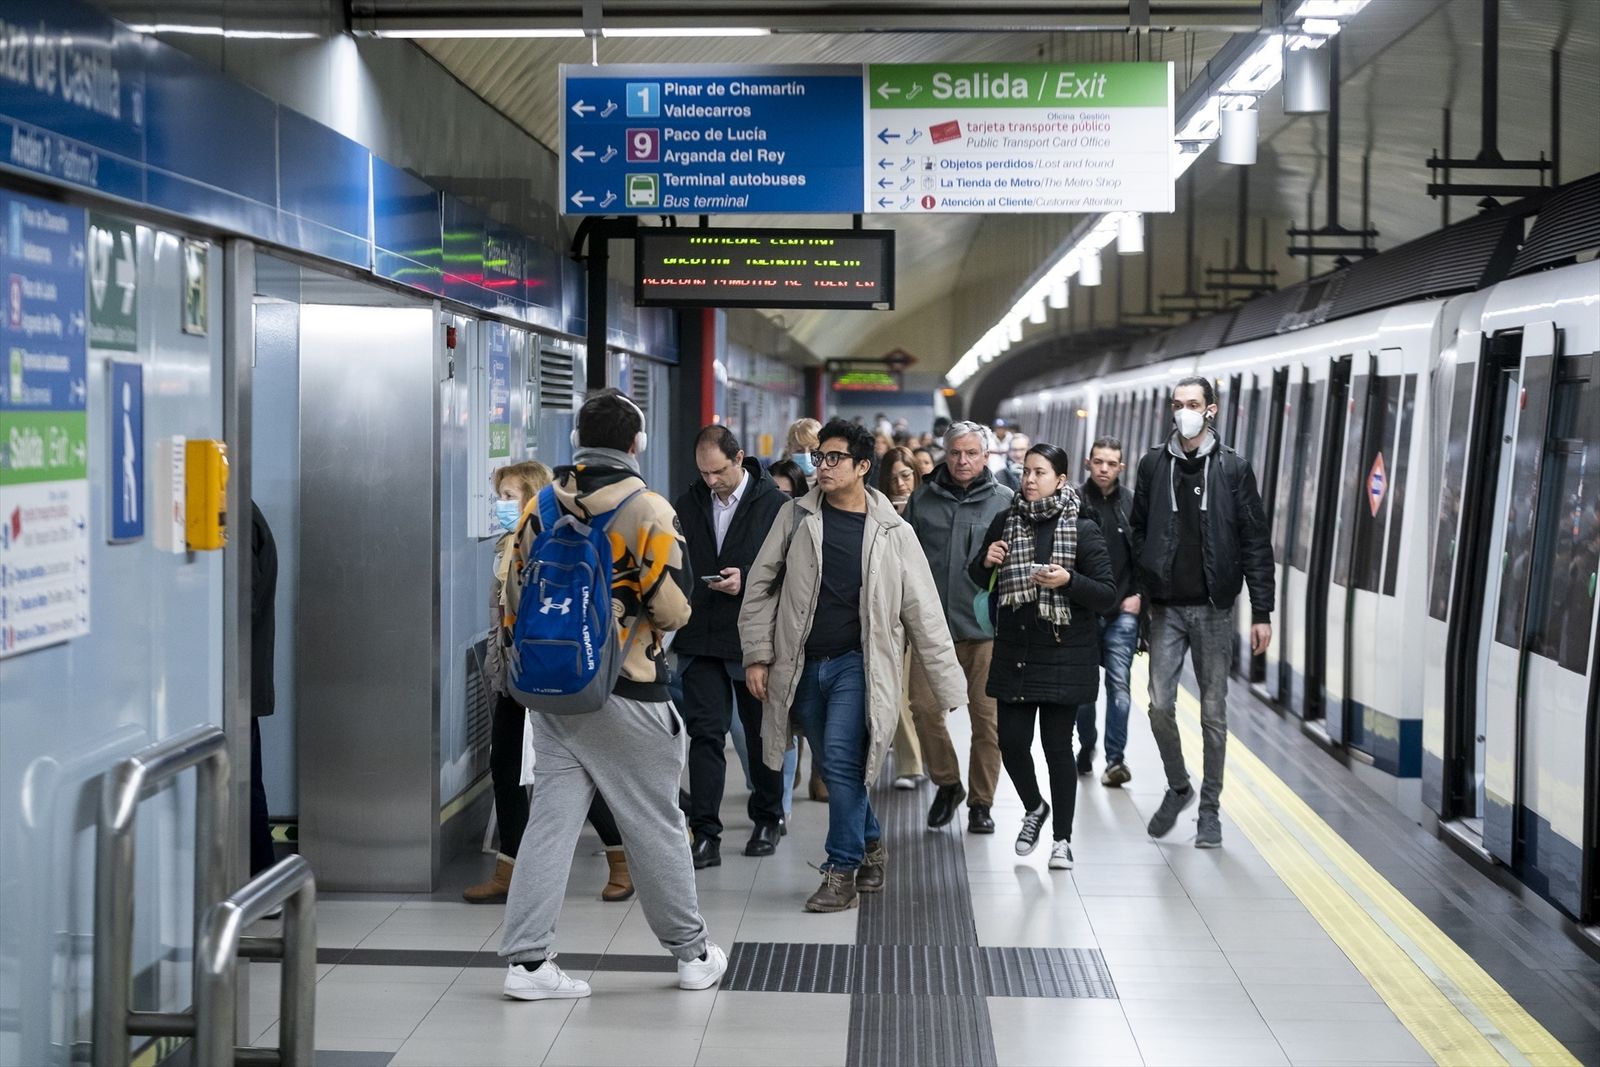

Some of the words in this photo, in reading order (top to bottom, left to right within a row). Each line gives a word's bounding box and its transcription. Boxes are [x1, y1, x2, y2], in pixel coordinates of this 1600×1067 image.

[665, 83, 702, 95] Pinar
[707, 83, 724, 95] de
[730, 82, 804, 95] Chamartín
[932, 72, 1028, 99] Salida
[1056, 72, 1107, 99] Exit
[637, 87, 649, 113] 1
[664, 104, 751, 117] Valdecarros
[665, 128, 700, 141] Paco
[705, 128, 723, 140] de
[728, 127, 766, 140] Lucía
[967, 122, 1004, 134] tarjeta
[1009, 122, 1068, 133] transporte
[1072, 121, 1110, 133] público
[634, 133, 652, 158] 9
[967, 137, 998, 147] Public
[1003, 137, 1049, 149] Transport
[1053, 137, 1077, 147] Card
[1081, 137, 1110, 147] Office
[664, 149, 725, 165] Arganda
[730, 149, 752, 162] del
[758, 149, 785, 164] Rey
[941, 160, 982, 171] Objetos
[1063, 160, 1082, 168] and
[1085, 159, 1114, 167] found
[663, 173, 724, 186] Terminal
[730, 173, 806, 185] autobuses
[941, 178, 953, 187] La
[957, 178, 991, 187] Tienda
[994, 179, 1007, 187] de
[1065, 177, 1093, 187] Metro
[1096, 177, 1121, 189] Shop
[663, 195, 690, 208] Bus
[694, 194, 748, 207] terminal
[941, 198, 984, 206] Atención
[988, 198, 995, 206] al
[1082, 197, 1122, 206] Attention
[582, 624, 595, 670] ARMOUR
